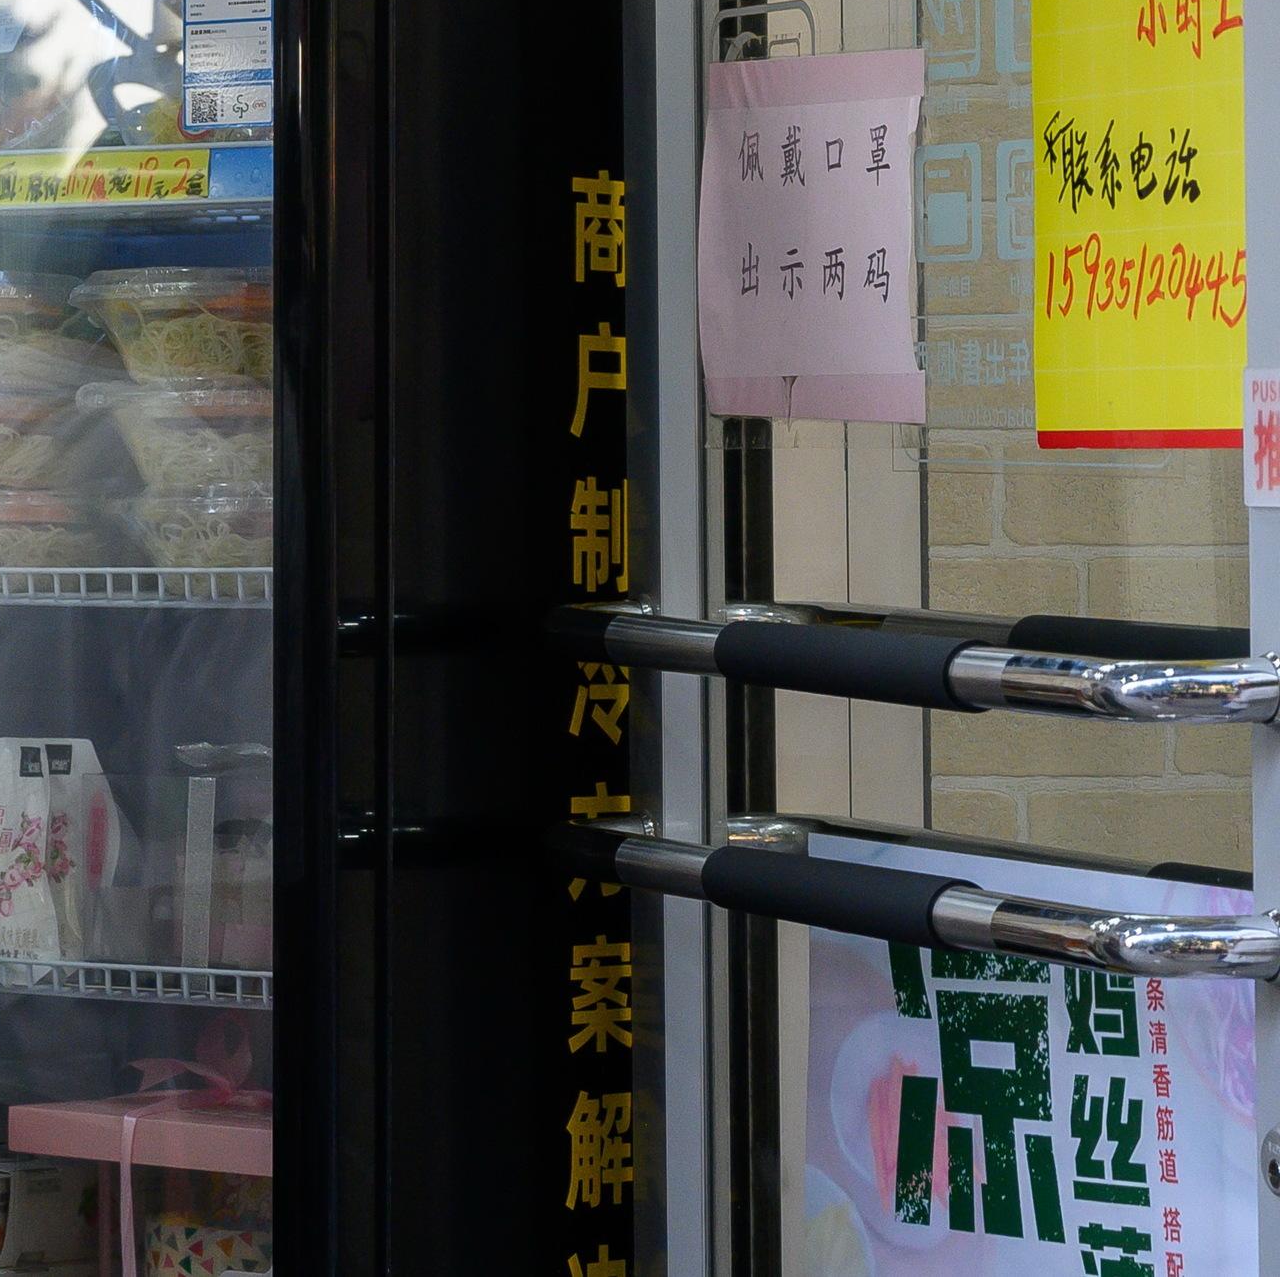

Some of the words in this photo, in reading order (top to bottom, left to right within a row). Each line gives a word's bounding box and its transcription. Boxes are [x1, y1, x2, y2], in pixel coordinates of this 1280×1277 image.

[738, 124, 891, 187] 佩戴口罩
[740, 242, 891, 304] 出示两码
[1045, 232, 1248, 329] 15935120445
[1251, 379, 1280, 403] PUS
[1145, 977, 1180, 1186] 条清香筋道
